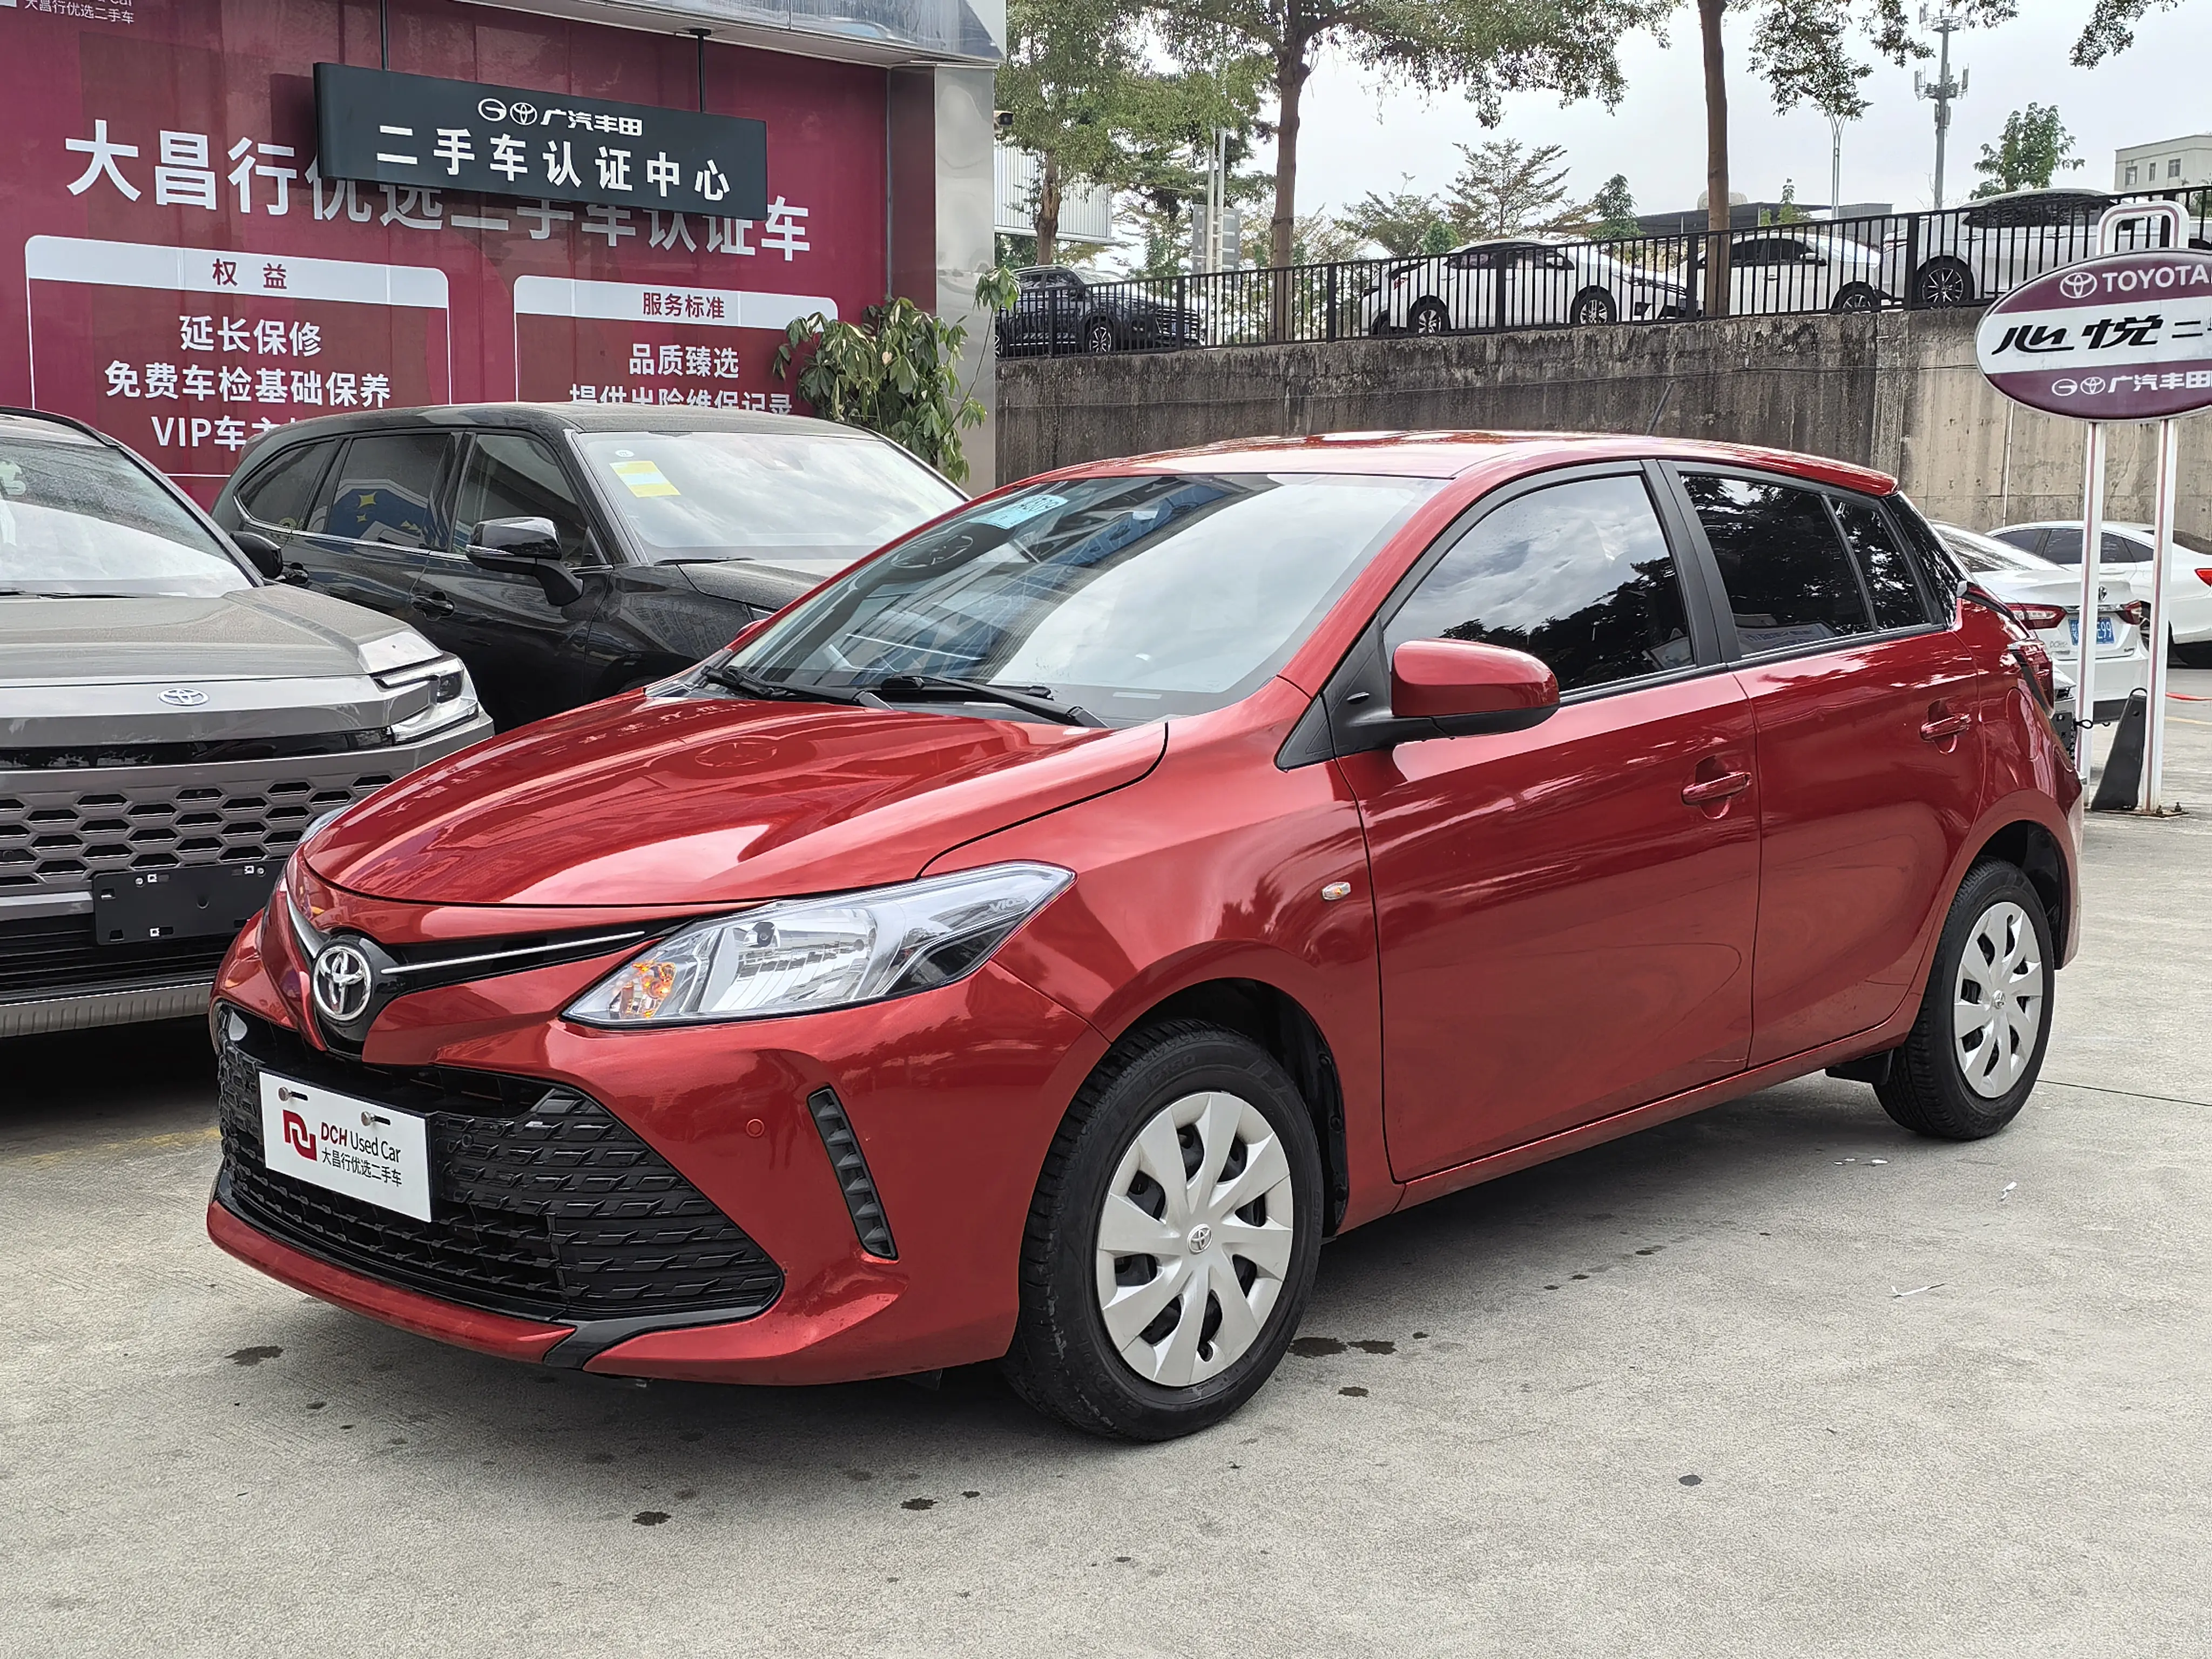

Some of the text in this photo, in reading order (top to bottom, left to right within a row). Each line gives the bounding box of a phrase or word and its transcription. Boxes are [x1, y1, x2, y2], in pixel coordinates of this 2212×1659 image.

[541, 109, 642, 136] 广汽丰田
[377, 125, 730, 201] 二手车认证中心
[2102, 264, 2209, 292] TOYOTA
[643, 292, 725, 319] 服务标准
[179, 315, 322, 357] 延长保修
[629, 344, 739, 379] 品质臻选
[105, 360, 391, 408] 免费车检基础保养
[2108, 370, 2210, 393] 广汽丰田
[321, 1122, 401, 1163] DCH Used Car
[322, 1147, 402, 1187] 大昌行优选二手车
